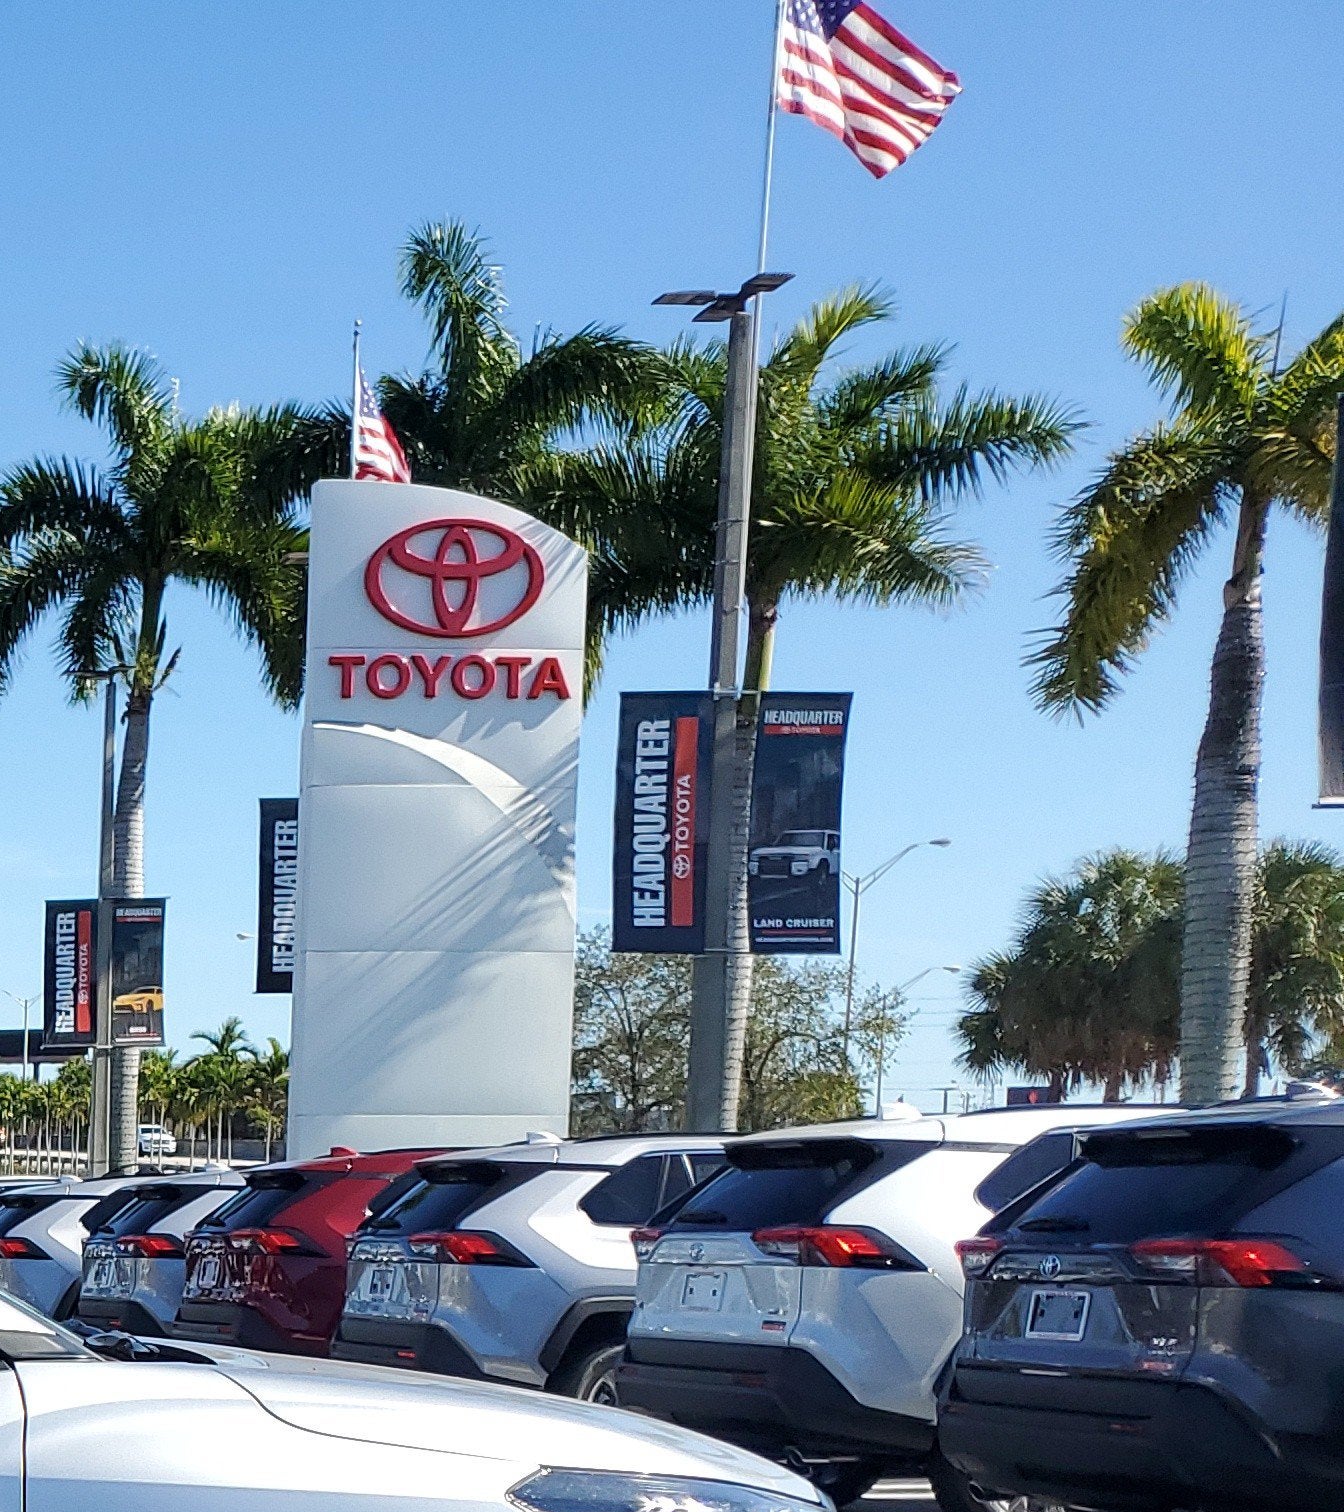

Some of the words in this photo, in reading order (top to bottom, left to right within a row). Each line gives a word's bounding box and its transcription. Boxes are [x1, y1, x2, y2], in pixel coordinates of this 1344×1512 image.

[328, 654, 571, 700] TOYOTA
[764, 710, 843, 726] HEADQUARTER
[632, 719, 671, 927] HEADQUARTER
[675, 774, 692, 853] TOYOTA
[271, 820, 298, 973] HEADQUARTER
[753, 919, 783, 928] LAND
[786, 919, 834, 928] CRUISER
[55, 912, 77, 1033] HEADQUARTER
[79, 943, 89, 990] TOYOTA
